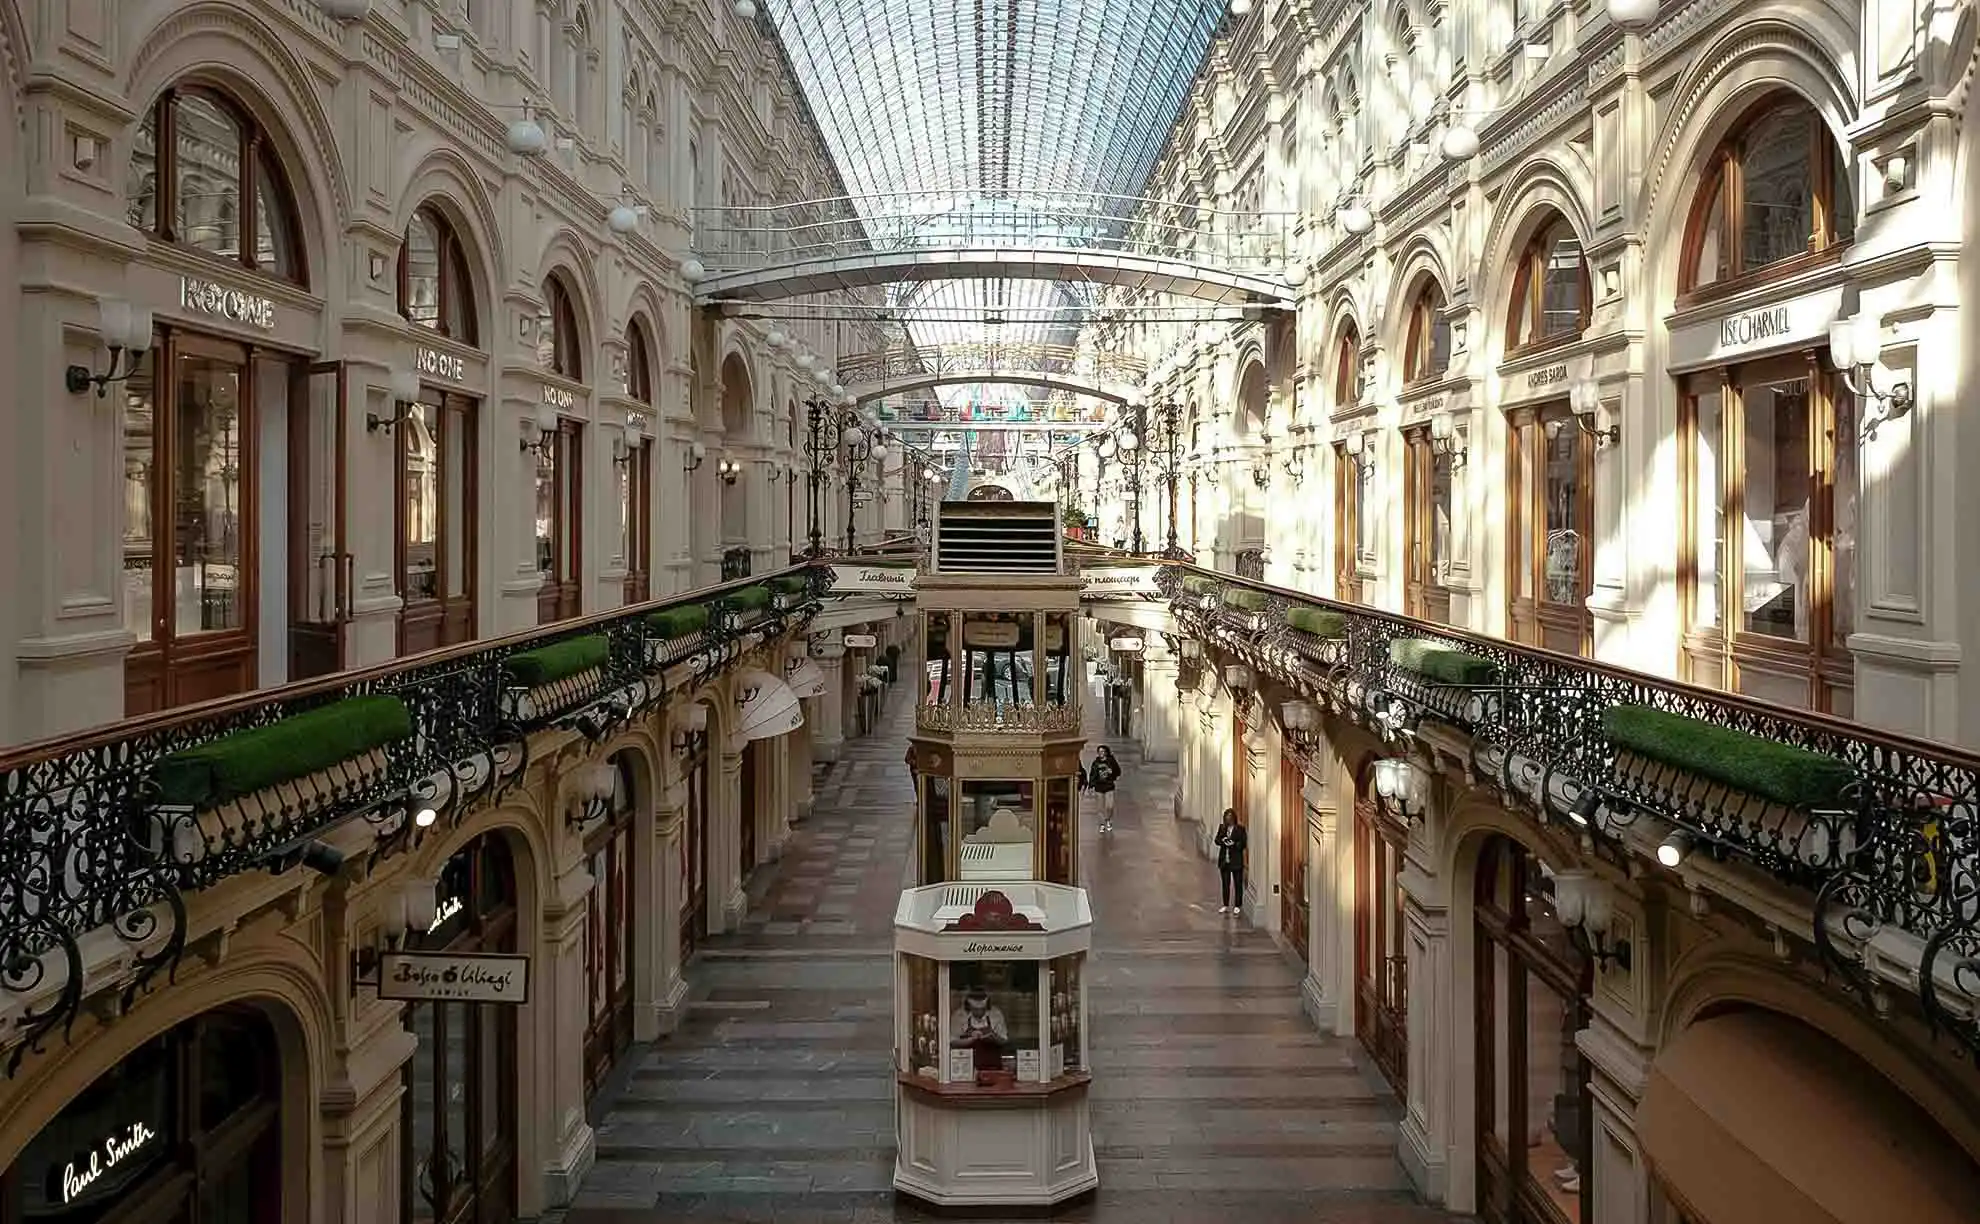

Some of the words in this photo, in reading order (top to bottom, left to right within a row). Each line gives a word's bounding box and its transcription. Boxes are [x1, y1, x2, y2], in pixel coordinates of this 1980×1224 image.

[1720, 318, 1738, 347] LISE
[1738, 306, 1791, 345] CHARMEL
[417, 347, 436, 373] NO
[438, 354, 464, 380] ONE
[543, 384, 556, 405] NO
[858, 569, 906, 583] Главный
[963, 941, 1024, 956] Мороженое
[393, 962, 440, 987] Bosco
[461, 961, 512, 993] Ciliegi
[63, 1162, 102, 1204] Paul
[106, 1121, 155, 1167] Smith
